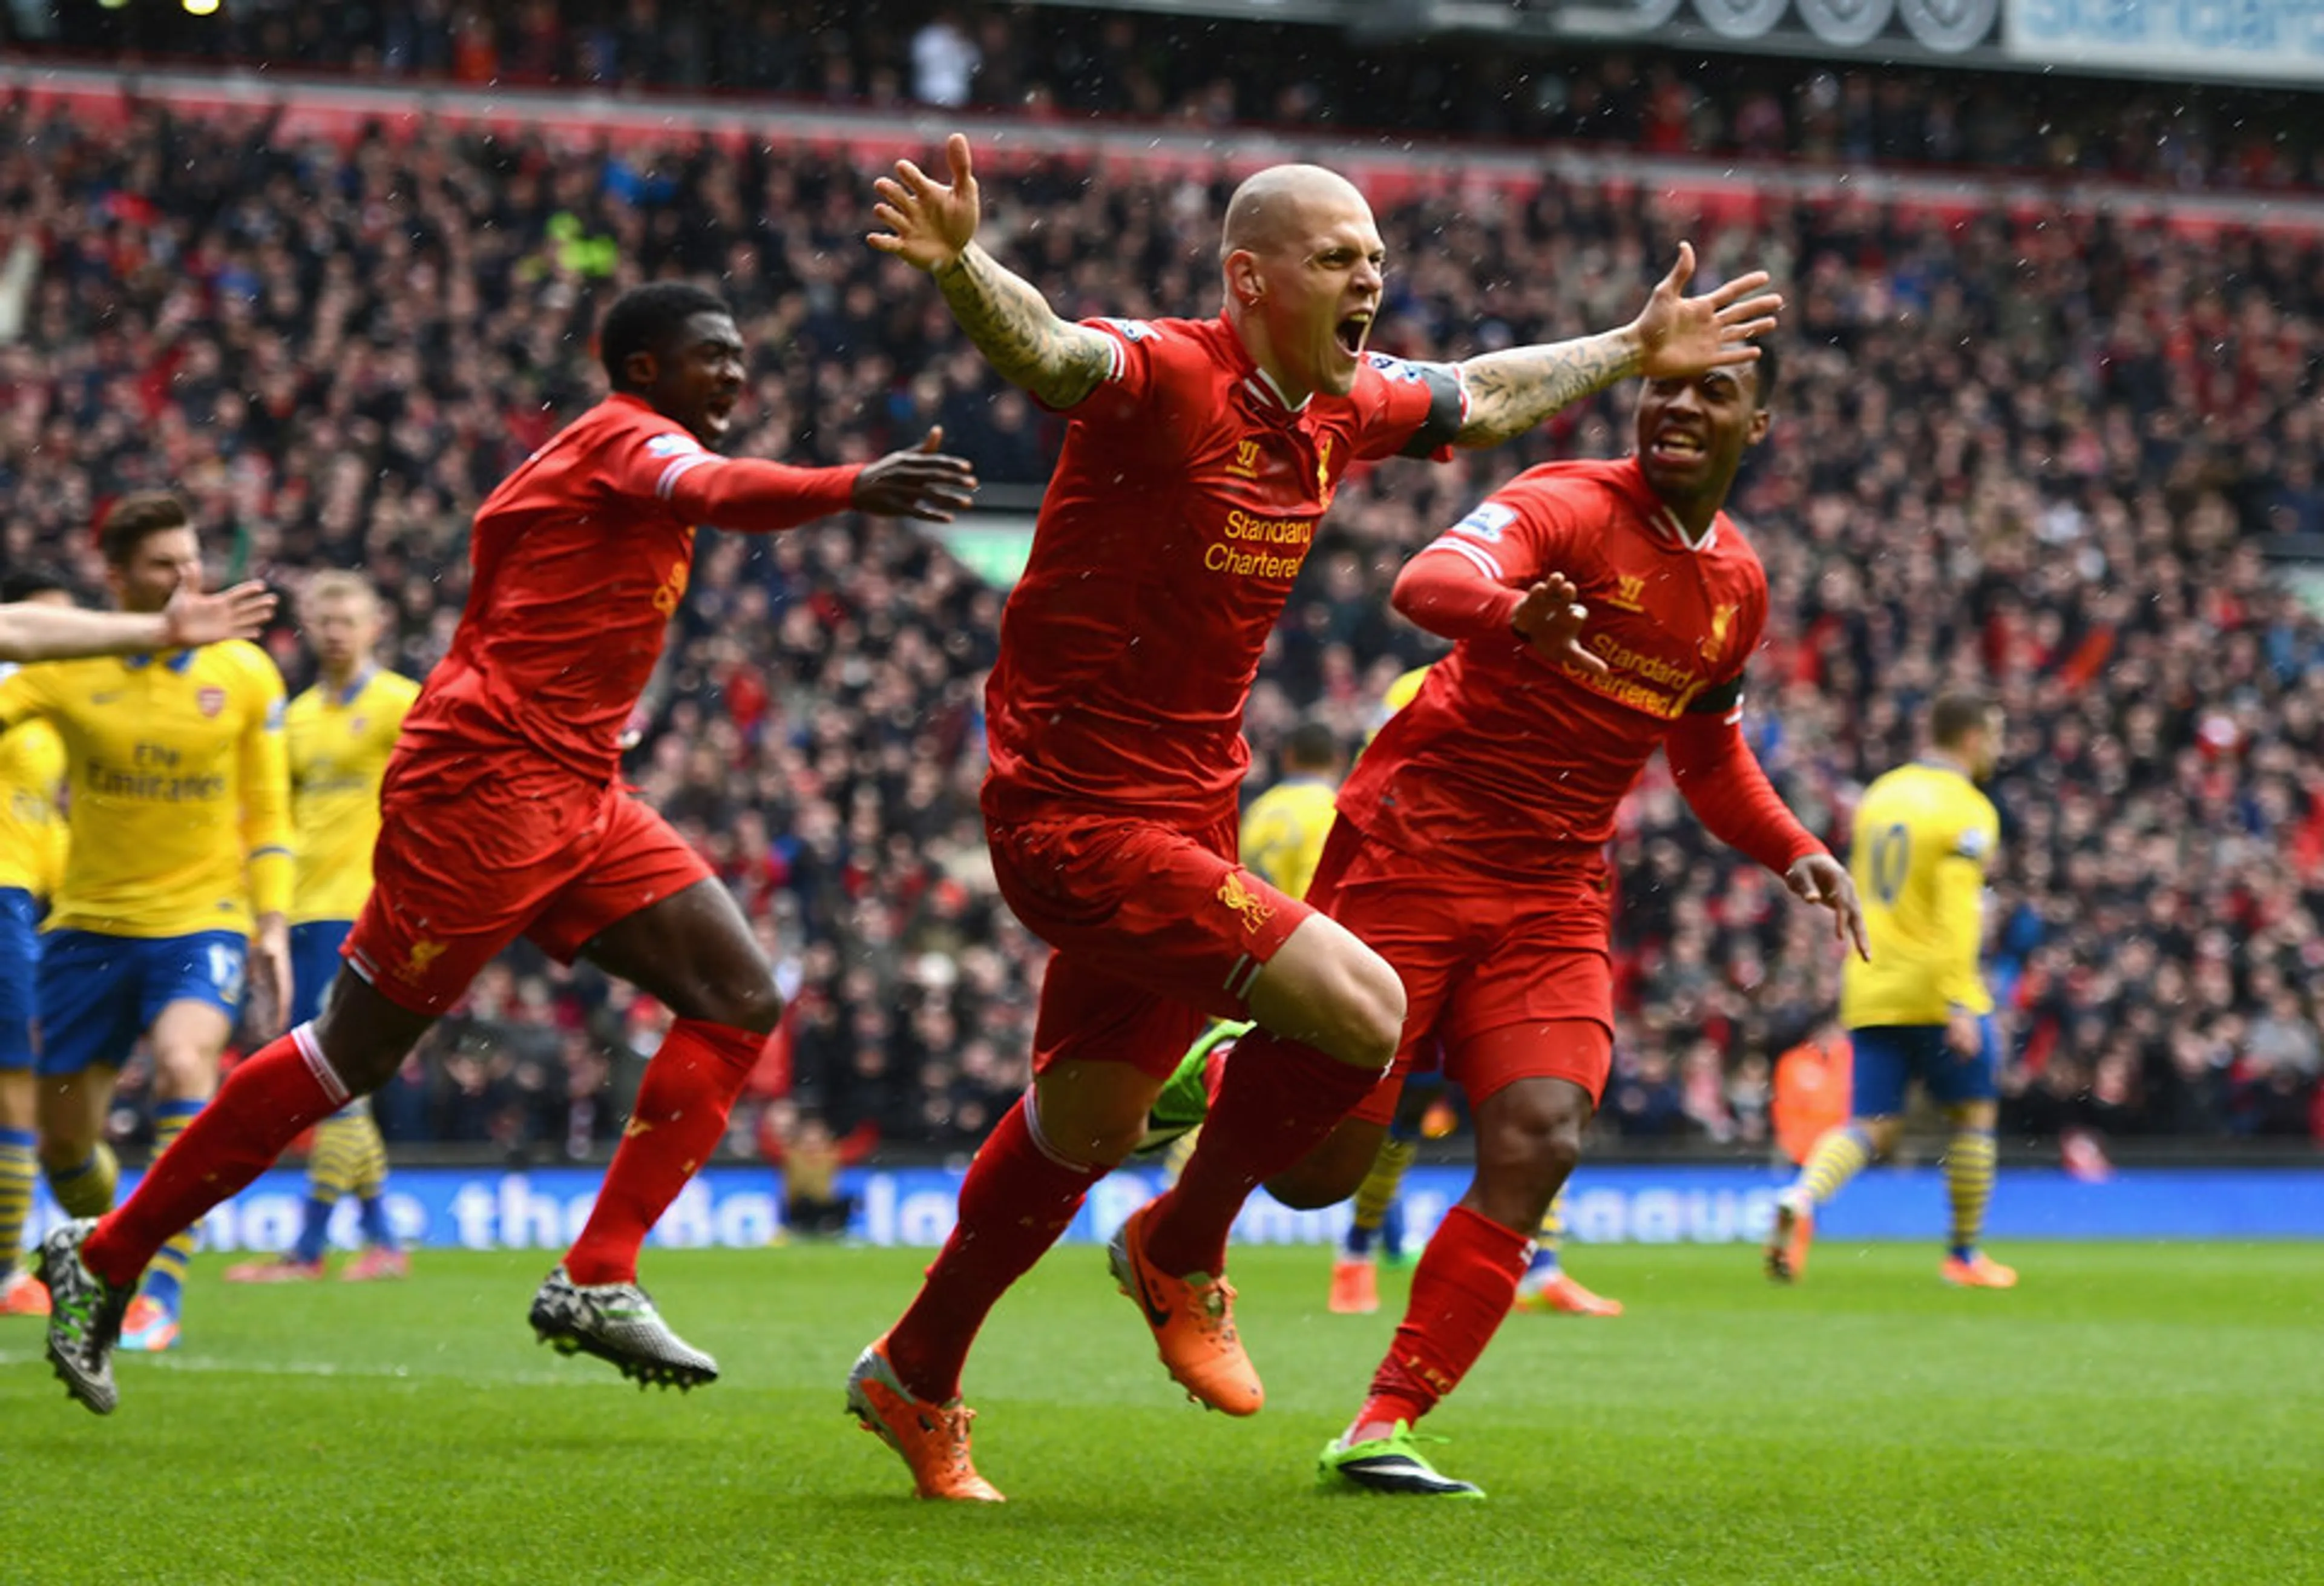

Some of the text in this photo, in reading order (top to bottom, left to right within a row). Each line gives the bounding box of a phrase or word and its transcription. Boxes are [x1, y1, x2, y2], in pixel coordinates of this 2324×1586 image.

[1587, 633, 1695, 691] Standard
[134, 743, 181, 769] Fly
[86, 760, 226, 802] Emirates
